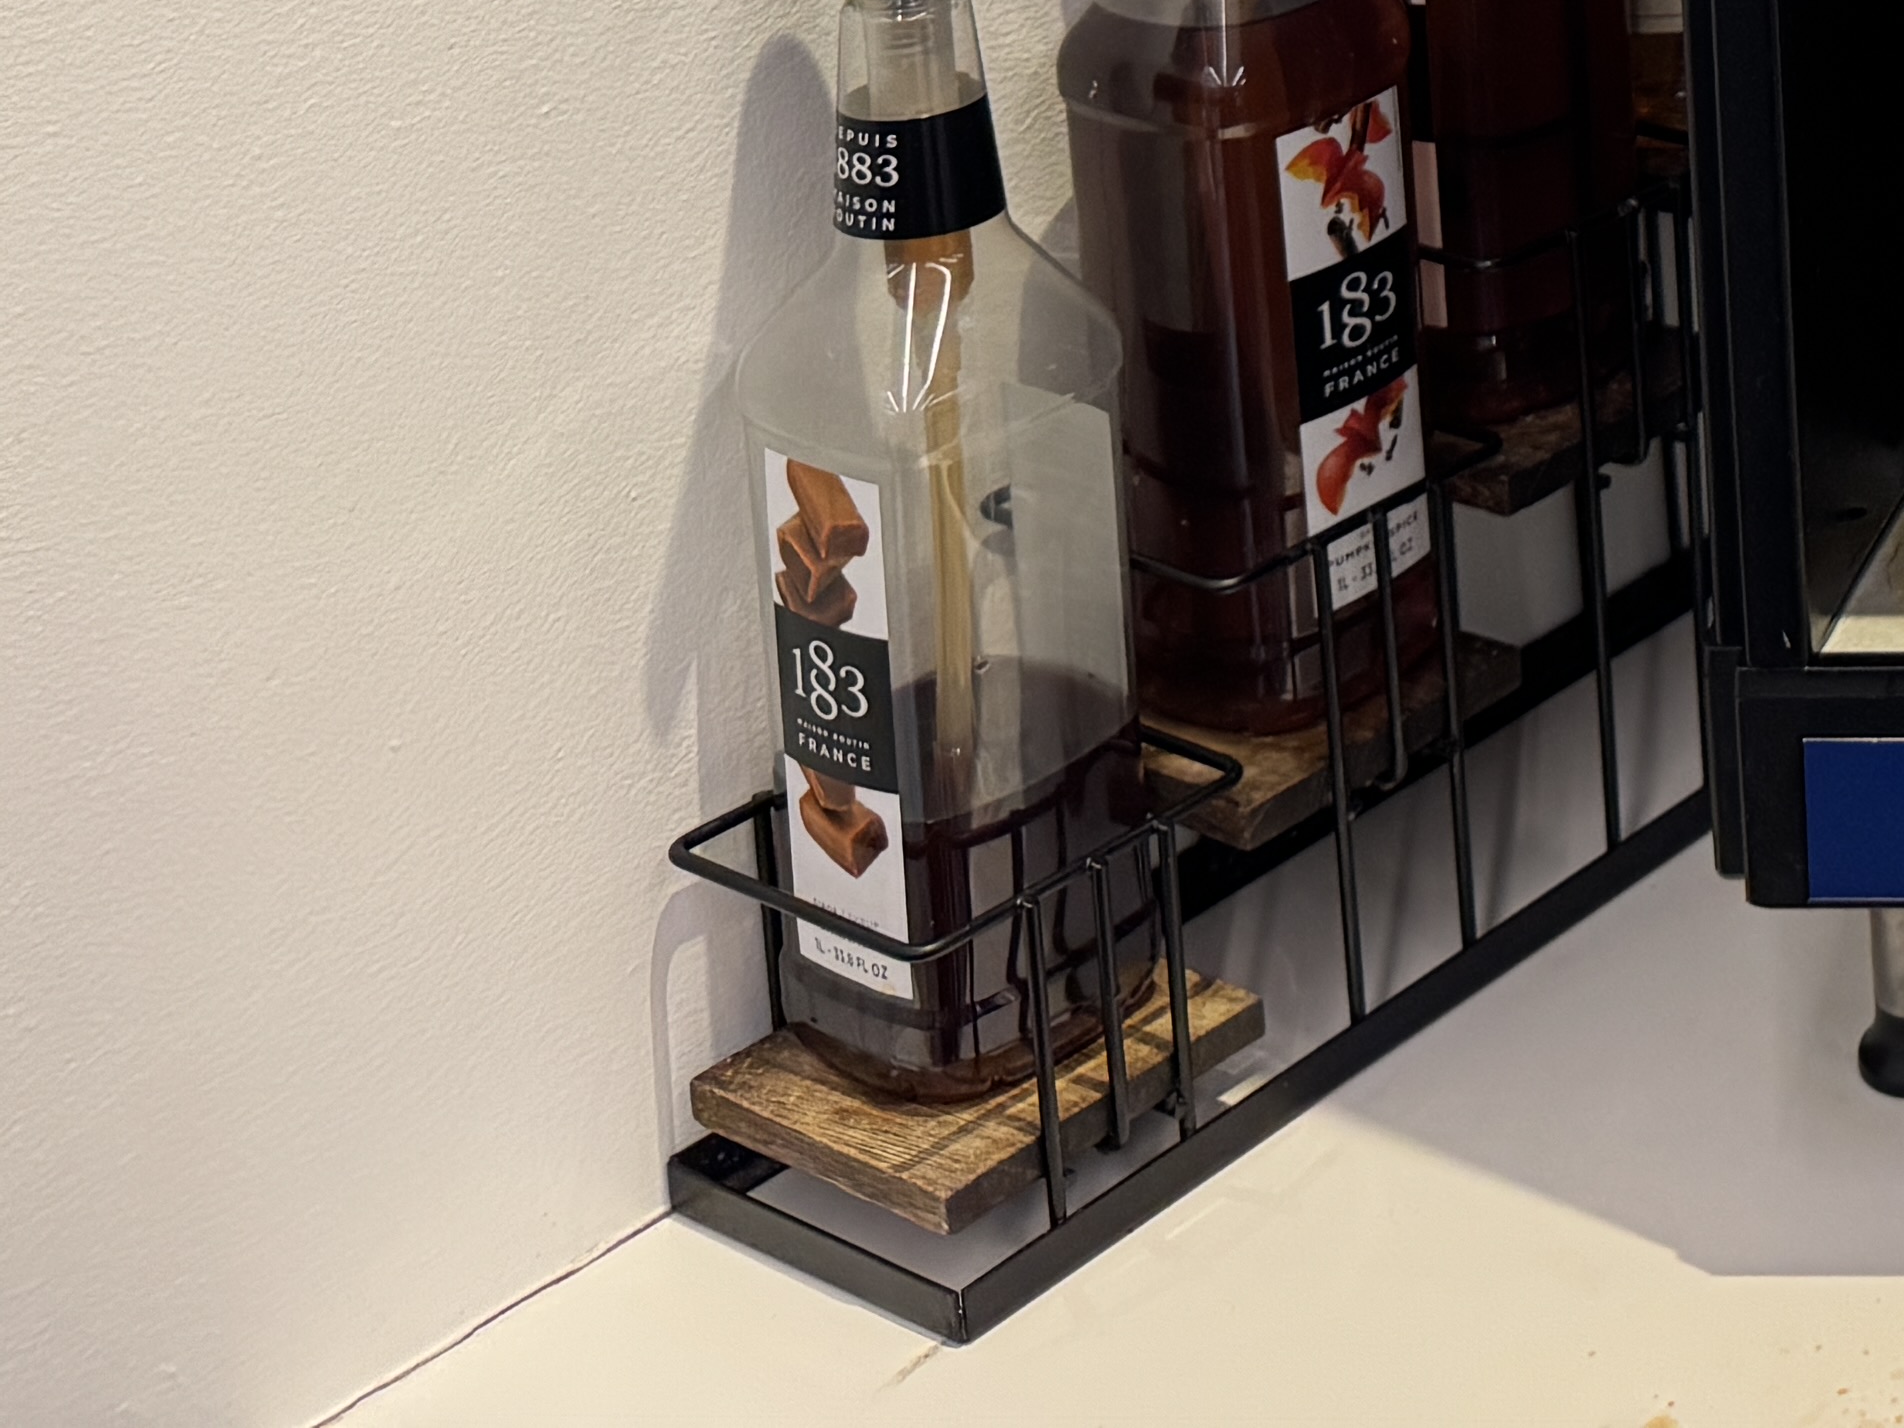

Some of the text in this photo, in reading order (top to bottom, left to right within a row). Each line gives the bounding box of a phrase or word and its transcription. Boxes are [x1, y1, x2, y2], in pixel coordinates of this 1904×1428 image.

[838, 126, 898, 148] EPUIS
[836, 192, 895, 213] AISON
[1324, 347, 1399, 398] FRANCE
[798, 732, 872, 771] FRANCE
